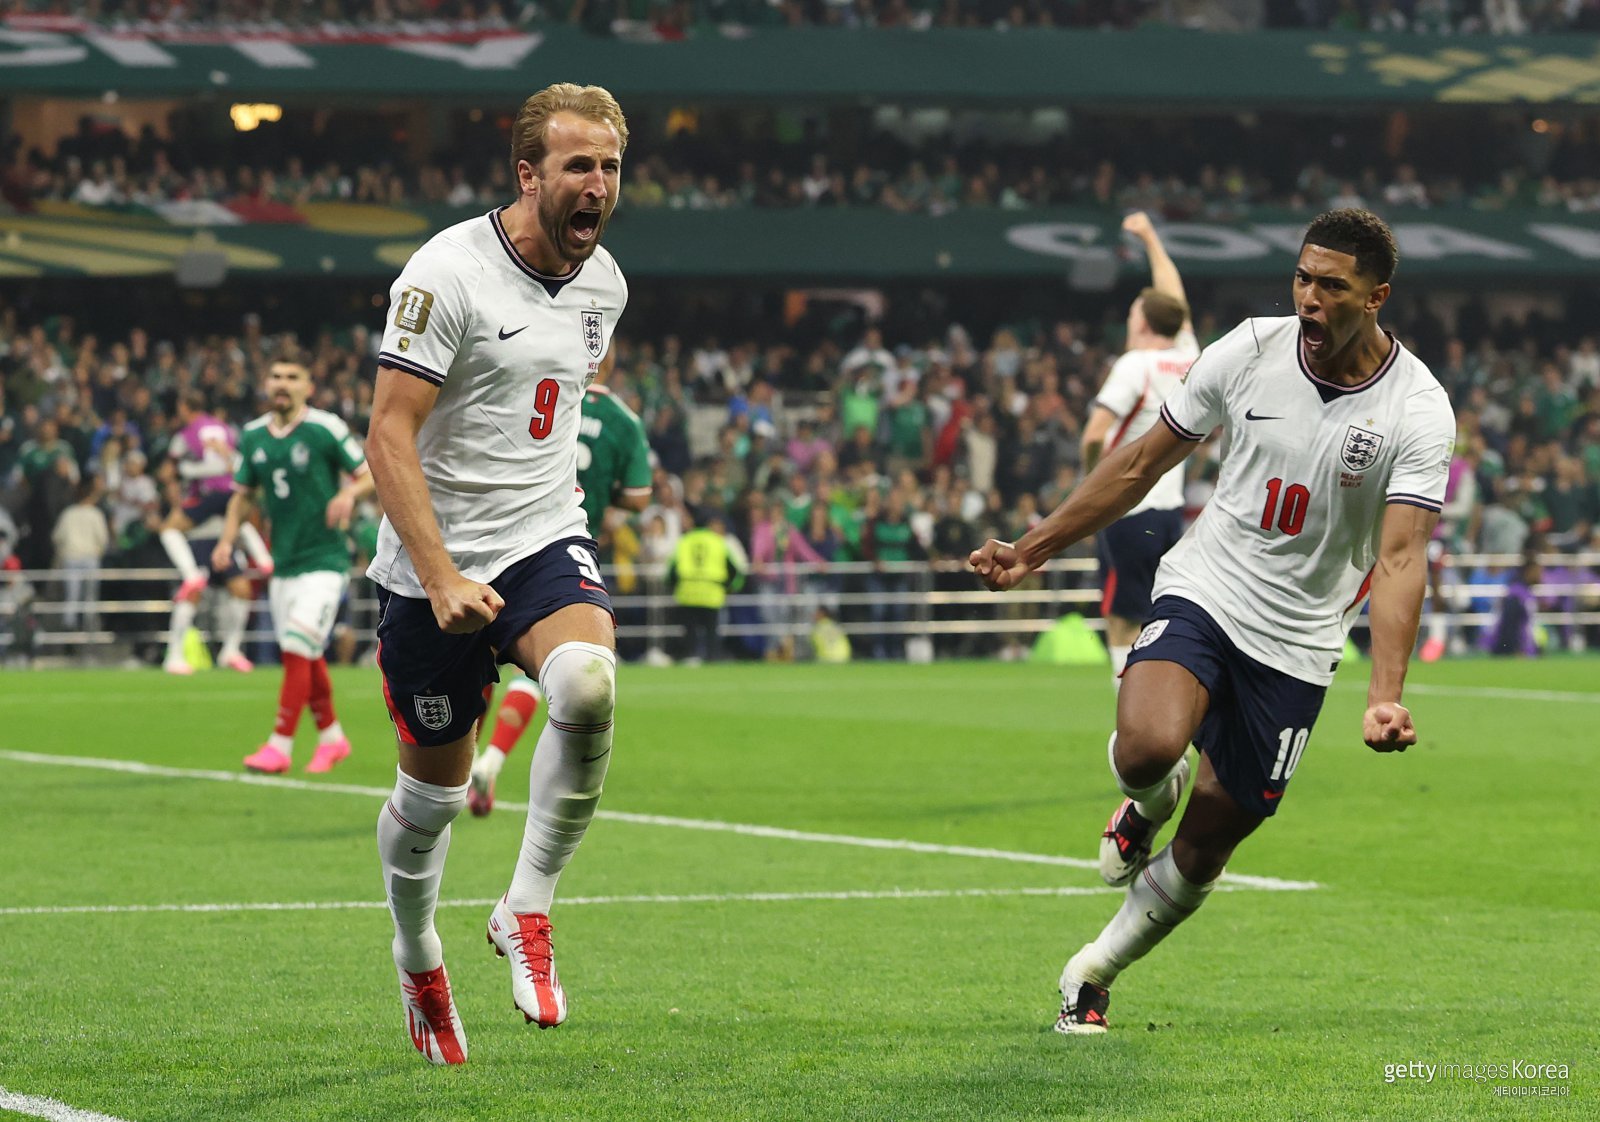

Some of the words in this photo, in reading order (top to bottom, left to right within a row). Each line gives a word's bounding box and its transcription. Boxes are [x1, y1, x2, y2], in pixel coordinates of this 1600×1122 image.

[529, 378, 560, 440] 9
[271, 468, 291, 499] 5
[1260, 477, 1311, 536] 10
[566, 544, 603, 584] 9
[1270, 727, 1309, 781] 10
